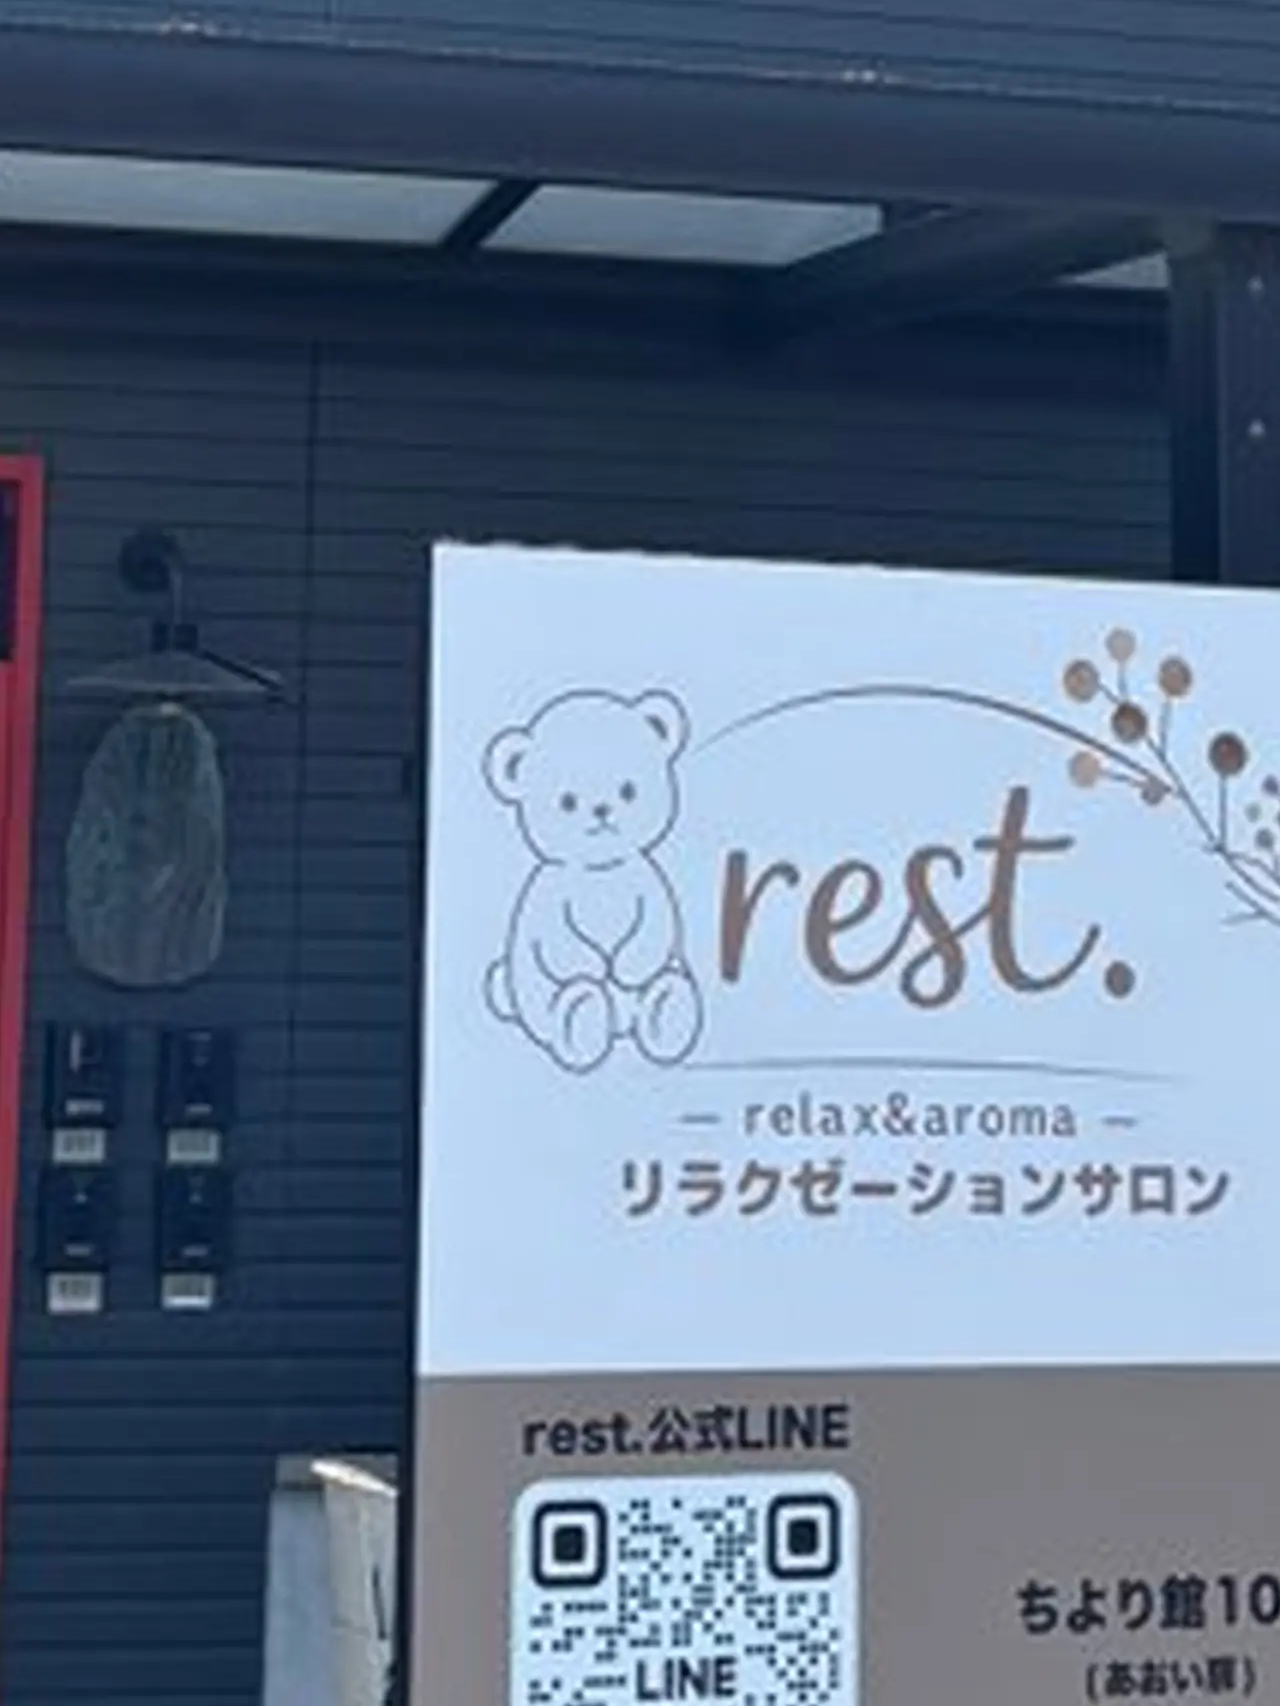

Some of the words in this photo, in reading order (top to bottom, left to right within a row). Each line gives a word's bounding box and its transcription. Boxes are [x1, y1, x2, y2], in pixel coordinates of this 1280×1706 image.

[720, 785, 1136, 1010] rest.
[744, 1090, 1078, 1139] relax&aroma
[621, 1157, 1230, 1219] リラクゼーションサロン
[523, 1403, 850, 1456] rest.公式LINE
[636, 1656, 736, 1702] LINE
